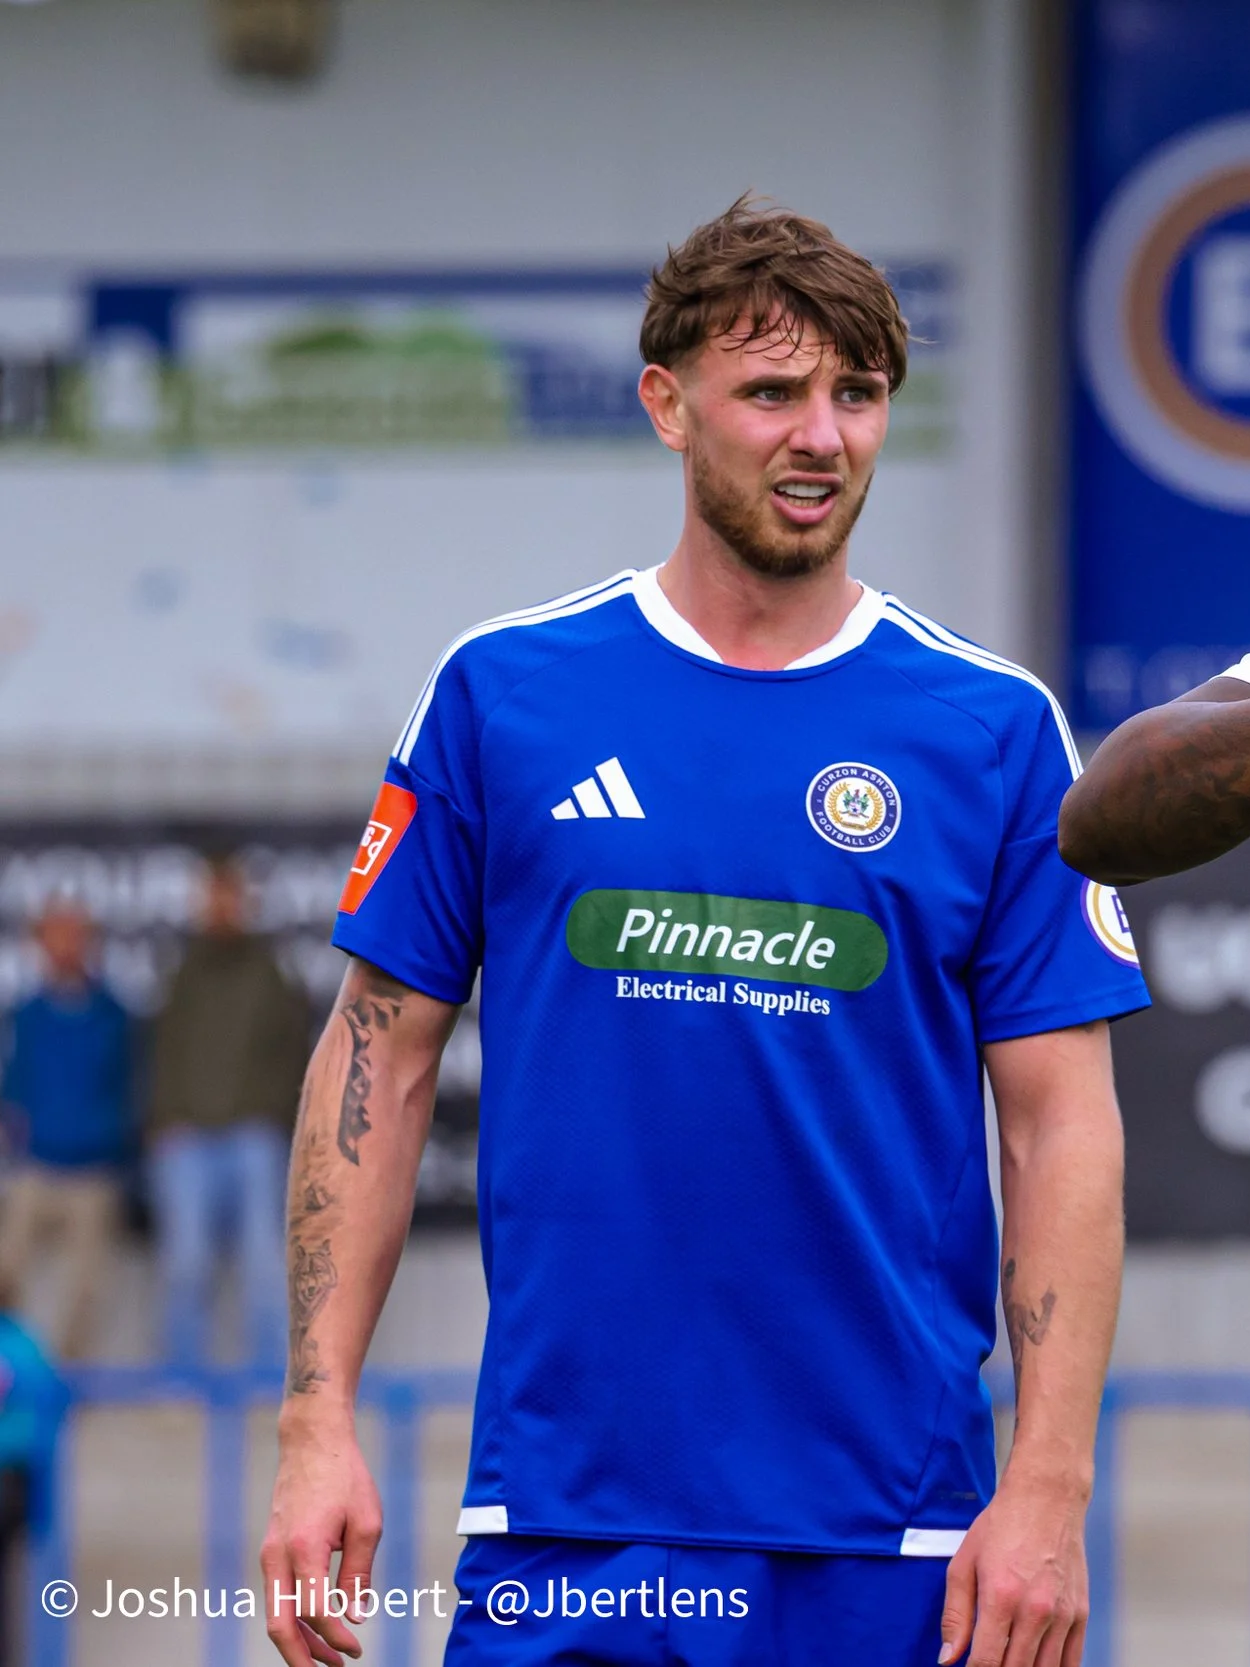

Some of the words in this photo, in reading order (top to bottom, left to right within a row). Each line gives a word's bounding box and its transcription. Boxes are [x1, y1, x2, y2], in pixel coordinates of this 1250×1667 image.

[817, 768, 858, 793] CURZON
[862, 771, 895, 806] ASHTON
[816, 811, 864, 845] FOOTBALL
[867, 825, 892, 844] CLUB
[616, 908, 836, 970] Pinnacle
[615, 975, 726, 1004] Electrical
[733, 982, 831, 1016] Supplies
